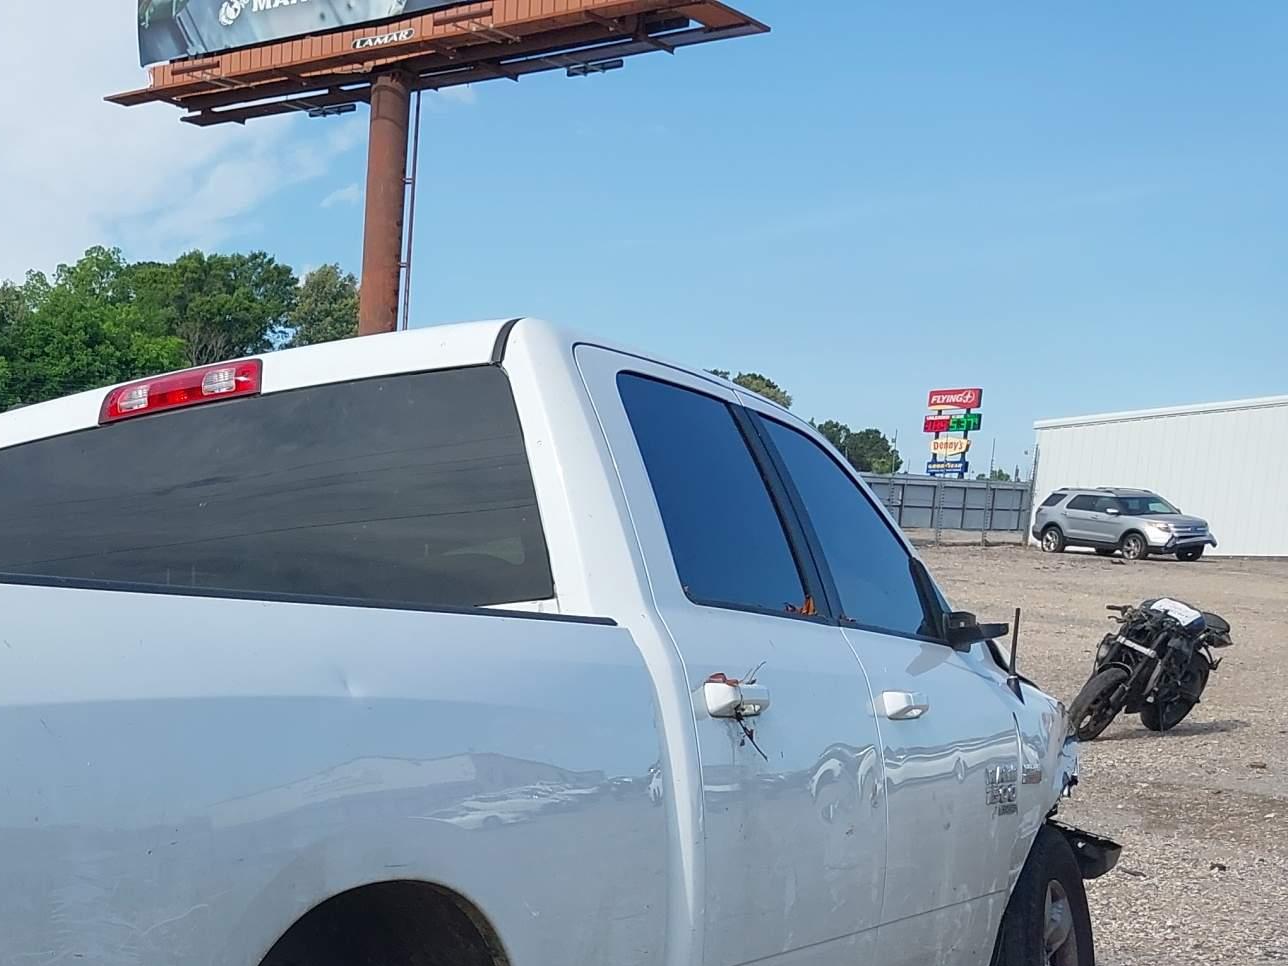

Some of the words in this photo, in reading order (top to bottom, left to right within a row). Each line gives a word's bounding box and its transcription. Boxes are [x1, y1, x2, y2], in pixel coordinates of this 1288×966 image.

[354, 30, 409, 49] LAMAR
[930, 393, 962, 404] FLYING
[933, 440, 963, 450] Denny's
